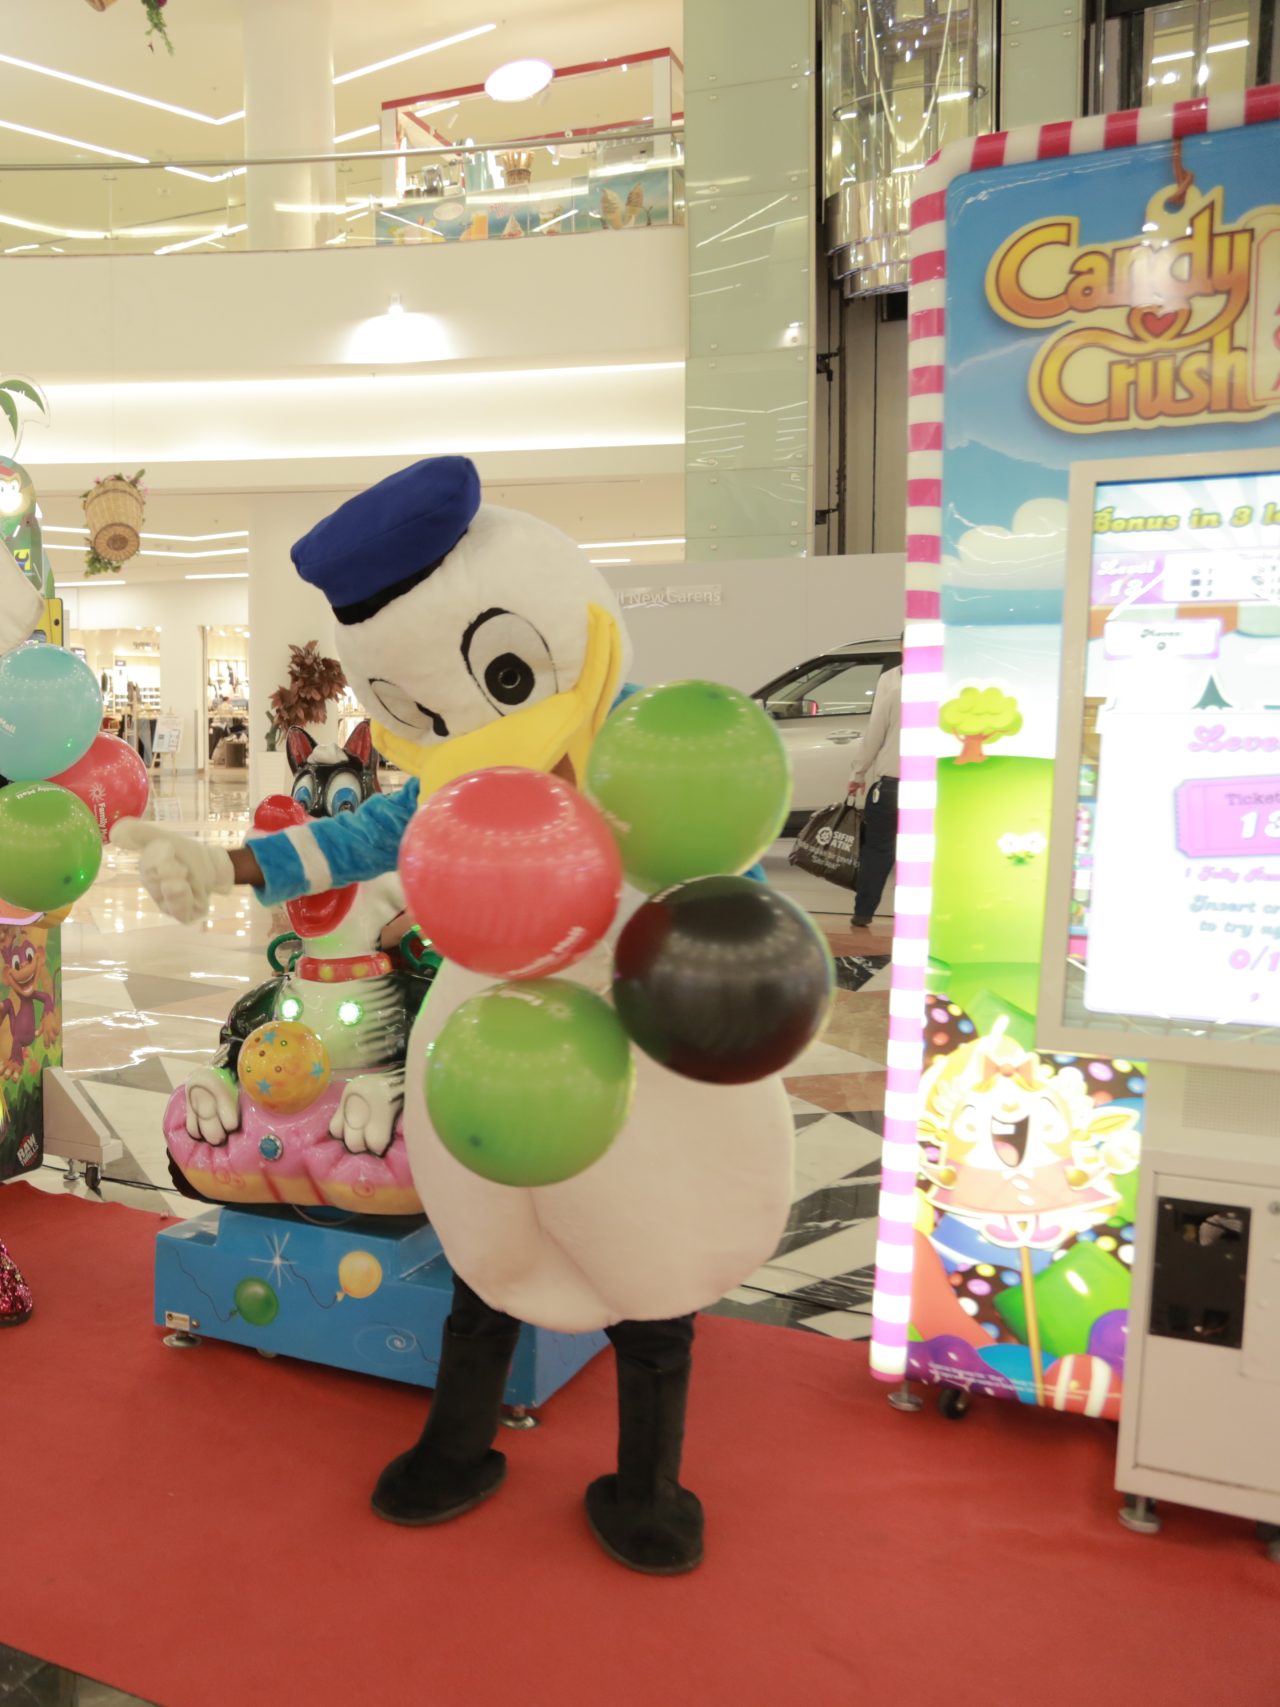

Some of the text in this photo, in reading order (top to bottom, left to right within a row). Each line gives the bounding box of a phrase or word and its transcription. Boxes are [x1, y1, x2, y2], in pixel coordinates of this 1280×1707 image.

[996, 199, 1254, 343] Candy
[1039, 326, 1266, 426] Crush
[1188, 508, 1222, 529] in
[1188, 724, 1280, 752] Leve
